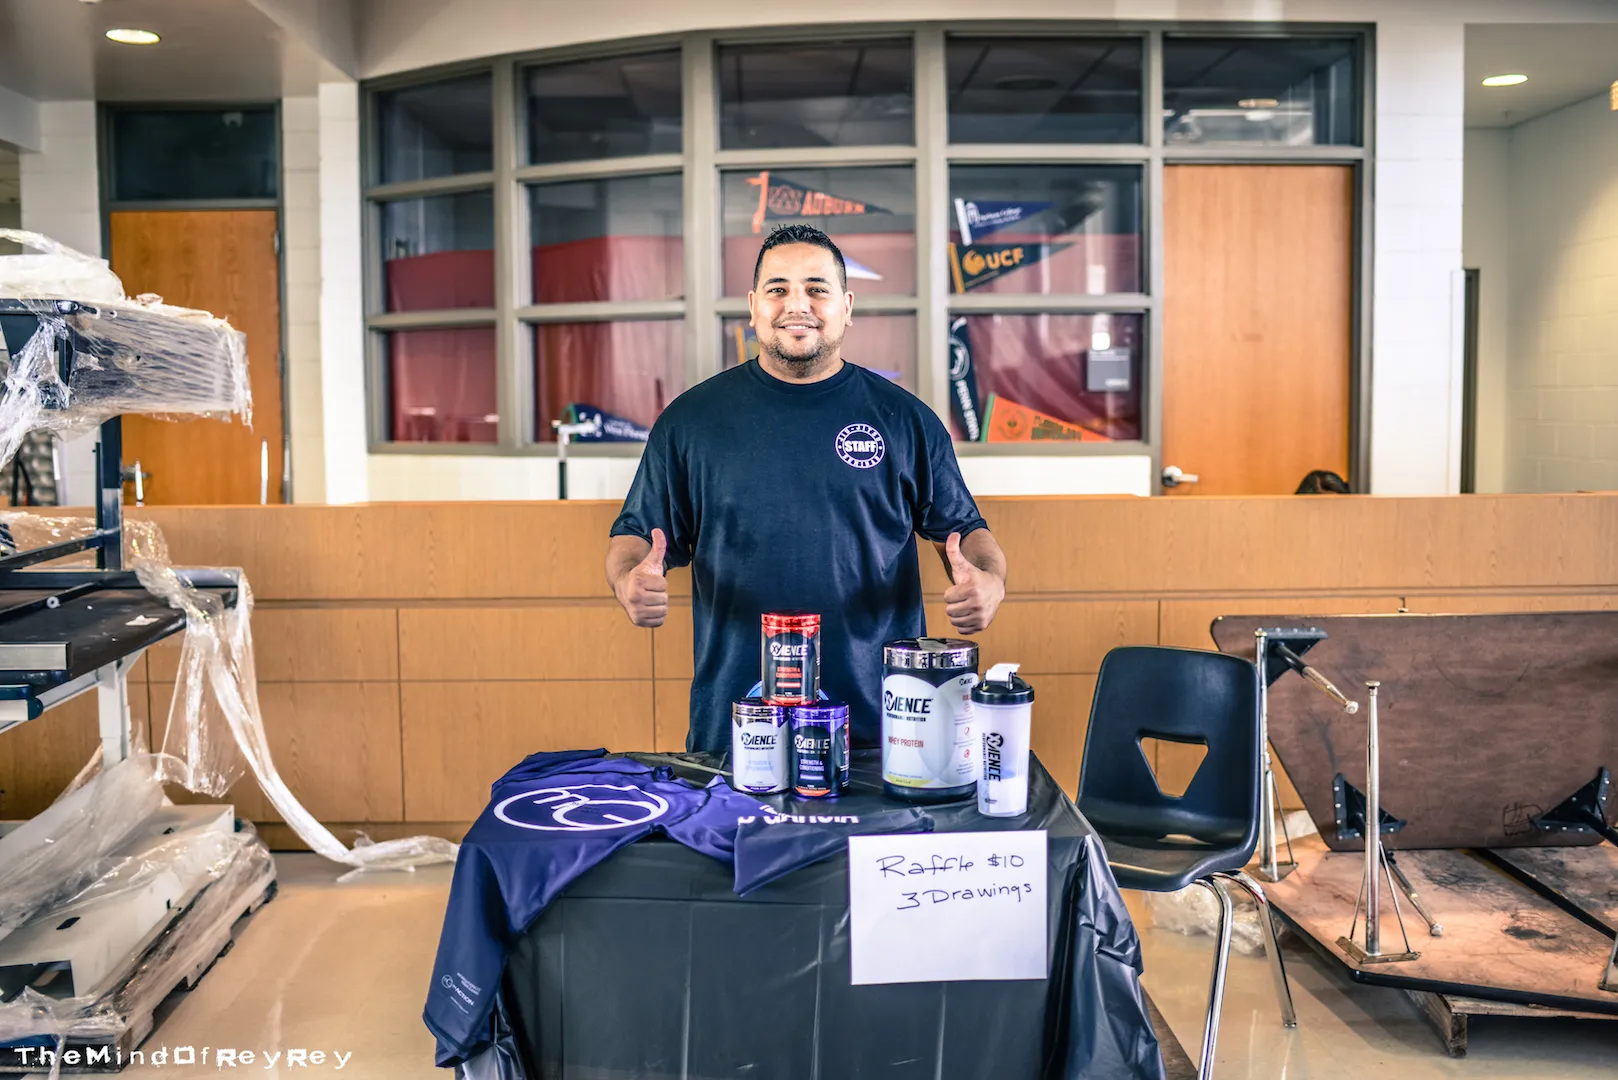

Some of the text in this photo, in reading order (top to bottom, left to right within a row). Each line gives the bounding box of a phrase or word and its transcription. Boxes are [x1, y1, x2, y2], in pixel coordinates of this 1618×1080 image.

[801, 190, 865, 216] AUBURN
[986, 247, 1024, 269] UCF
[955, 379, 973, 410] PENN
[844, 440, 877, 453] STAFF
[888, 736, 924, 748] WHEY PROTEIN
[876, 853, 1025, 878] Raffle $10
[897, 883, 1033, 910] 3 Drawings
